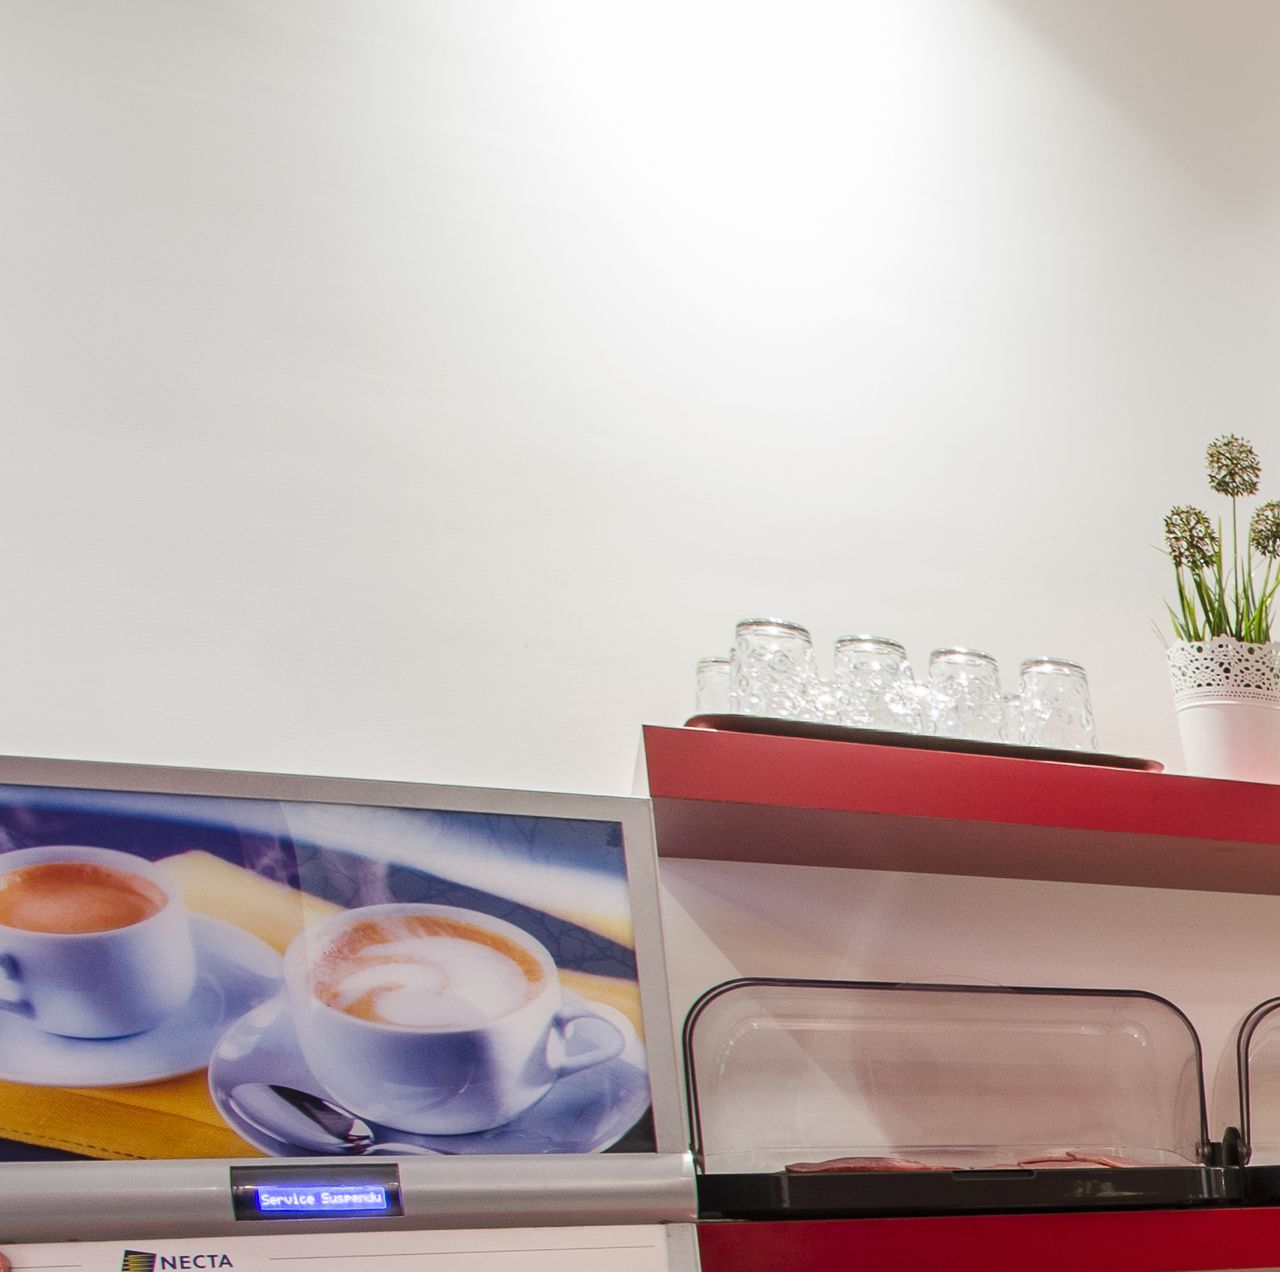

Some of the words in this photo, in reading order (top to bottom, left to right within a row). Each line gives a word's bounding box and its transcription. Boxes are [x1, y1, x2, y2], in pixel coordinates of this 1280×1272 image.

[261, 1192, 315, 1206] Service
[321, 1192, 382, 1205] Suspendu
[161, 1254, 233, 1270] NECTA
